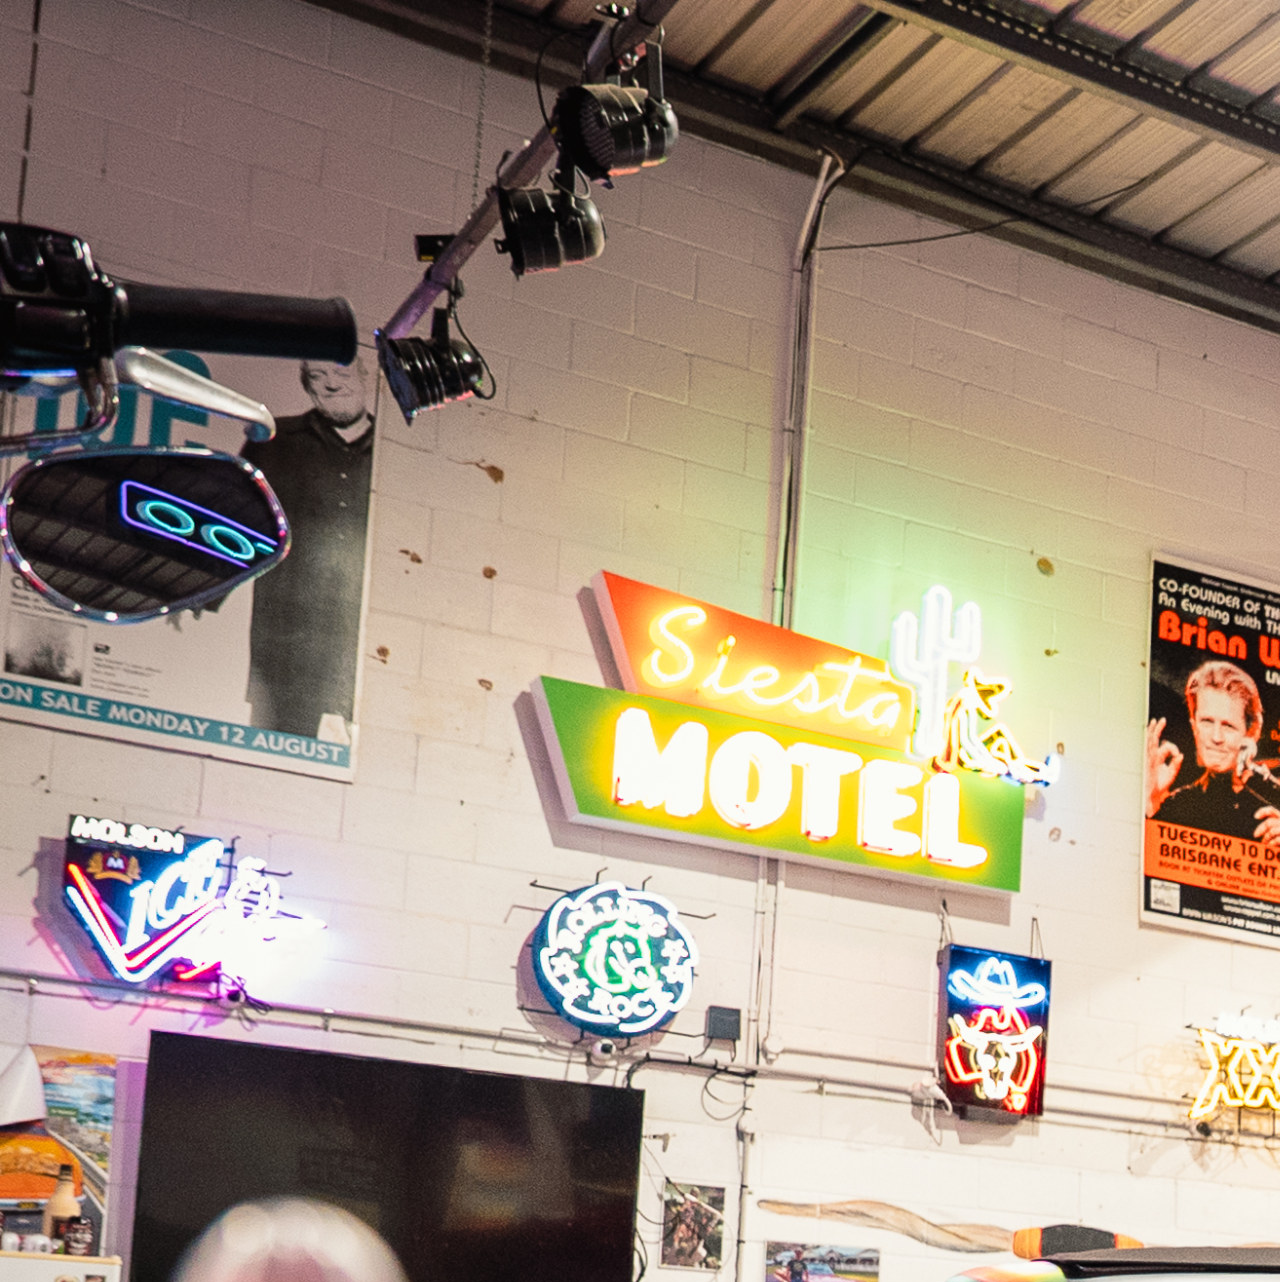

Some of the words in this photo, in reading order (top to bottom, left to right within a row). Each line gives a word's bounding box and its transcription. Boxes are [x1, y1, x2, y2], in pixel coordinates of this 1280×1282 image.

[1159, 578, 1240, 609] CO-FOUNDER
[1243, 600, 1260, 614] OF
[1159, 592, 1176, 608] An
[1181, 599, 1230, 625] Evening
[1234, 614, 1262, 630] with
[1159, 610, 1248, 660] Brian
[650, 606, 902, 736] Siesta
[0, 684, 33, 708] ON
[40, 691, 100, 720] SALE
[108, 703, 209, 738] MONDAY
[218, 722, 247, 746] 12
[251, 730, 344, 765] AUGUST
[612, 708, 988, 870] MOTEL
[71, 816, 184, 854] MOLSON
[1158, 825, 1232, 851] TUESDAY
[1240, 843, 1258, 858] 10
[1160, 844, 1241, 871] BRISBANE
[1248, 863, 1280, 881] ENT.
[549, 893, 670, 951] ROLLING
[588, 985, 674, 1019] ROCK
